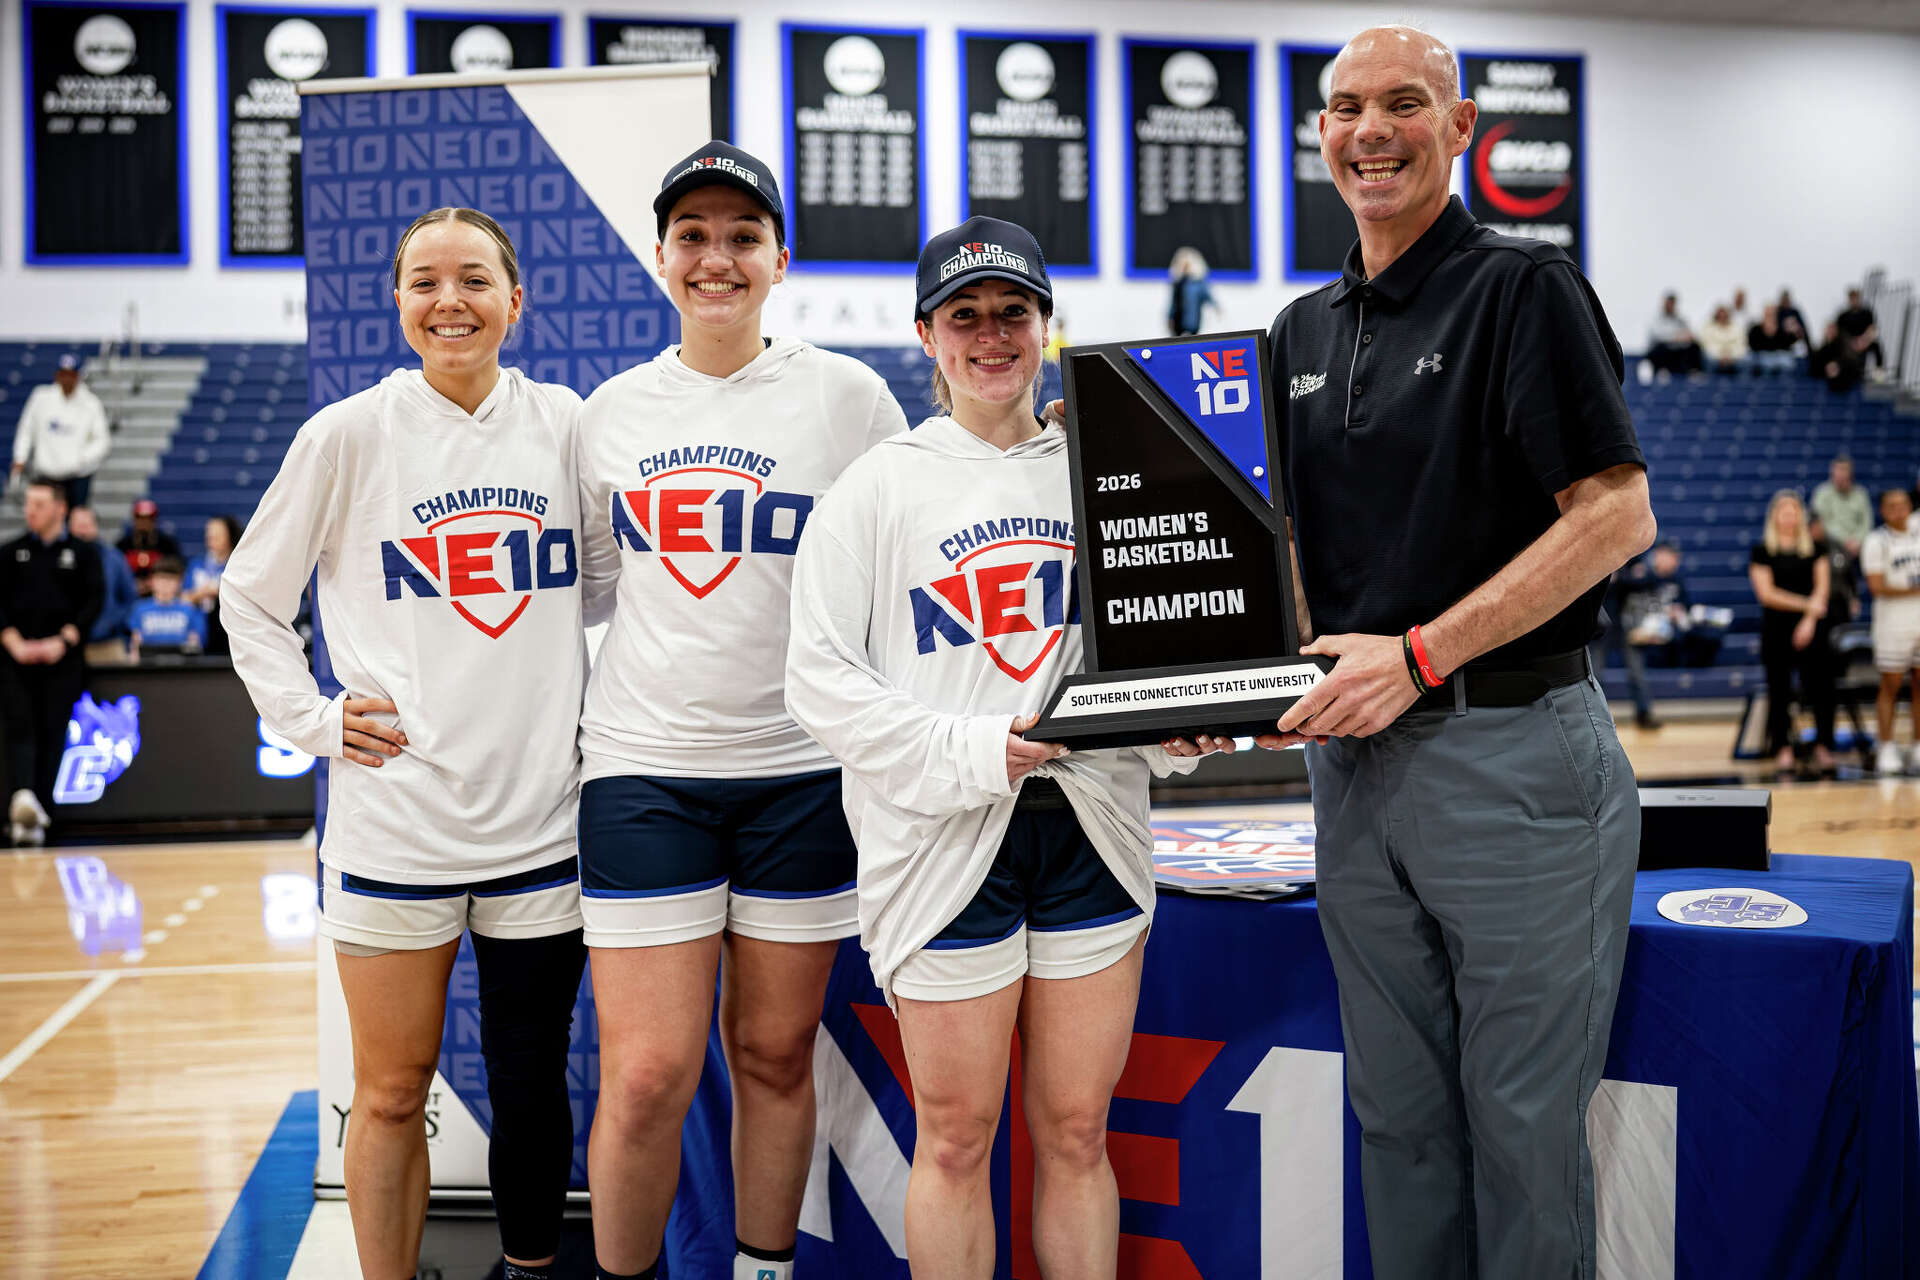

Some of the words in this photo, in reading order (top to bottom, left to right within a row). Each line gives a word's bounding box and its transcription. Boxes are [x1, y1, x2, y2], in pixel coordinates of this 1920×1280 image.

[943, 252, 1027, 278] CHAMPIONS
[959, 242, 1003, 257] NE10
[638, 445, 777, 479] CHAMPIONS
[1096, 473, 1142, 492] 2026
[411, 487, 549, 525] CHAMPIONS
[611, 488, 814, 556] NE10
[1100, 511, 1209, 541] WOMEN'S
[380, 528, 579, 601] NE10
[1102, 537, 1234, 569] BASKETBALL
[1106, 588, 1246, 625] CHAMPION
[1071, 691, 1131, 707] SOUTHERN
[1133, 683, 1209, 701] CONNECTICUT
[1211, 679, 1247, 694] STATE
[1248, 673, 1316, 691] UNIVERSITY
